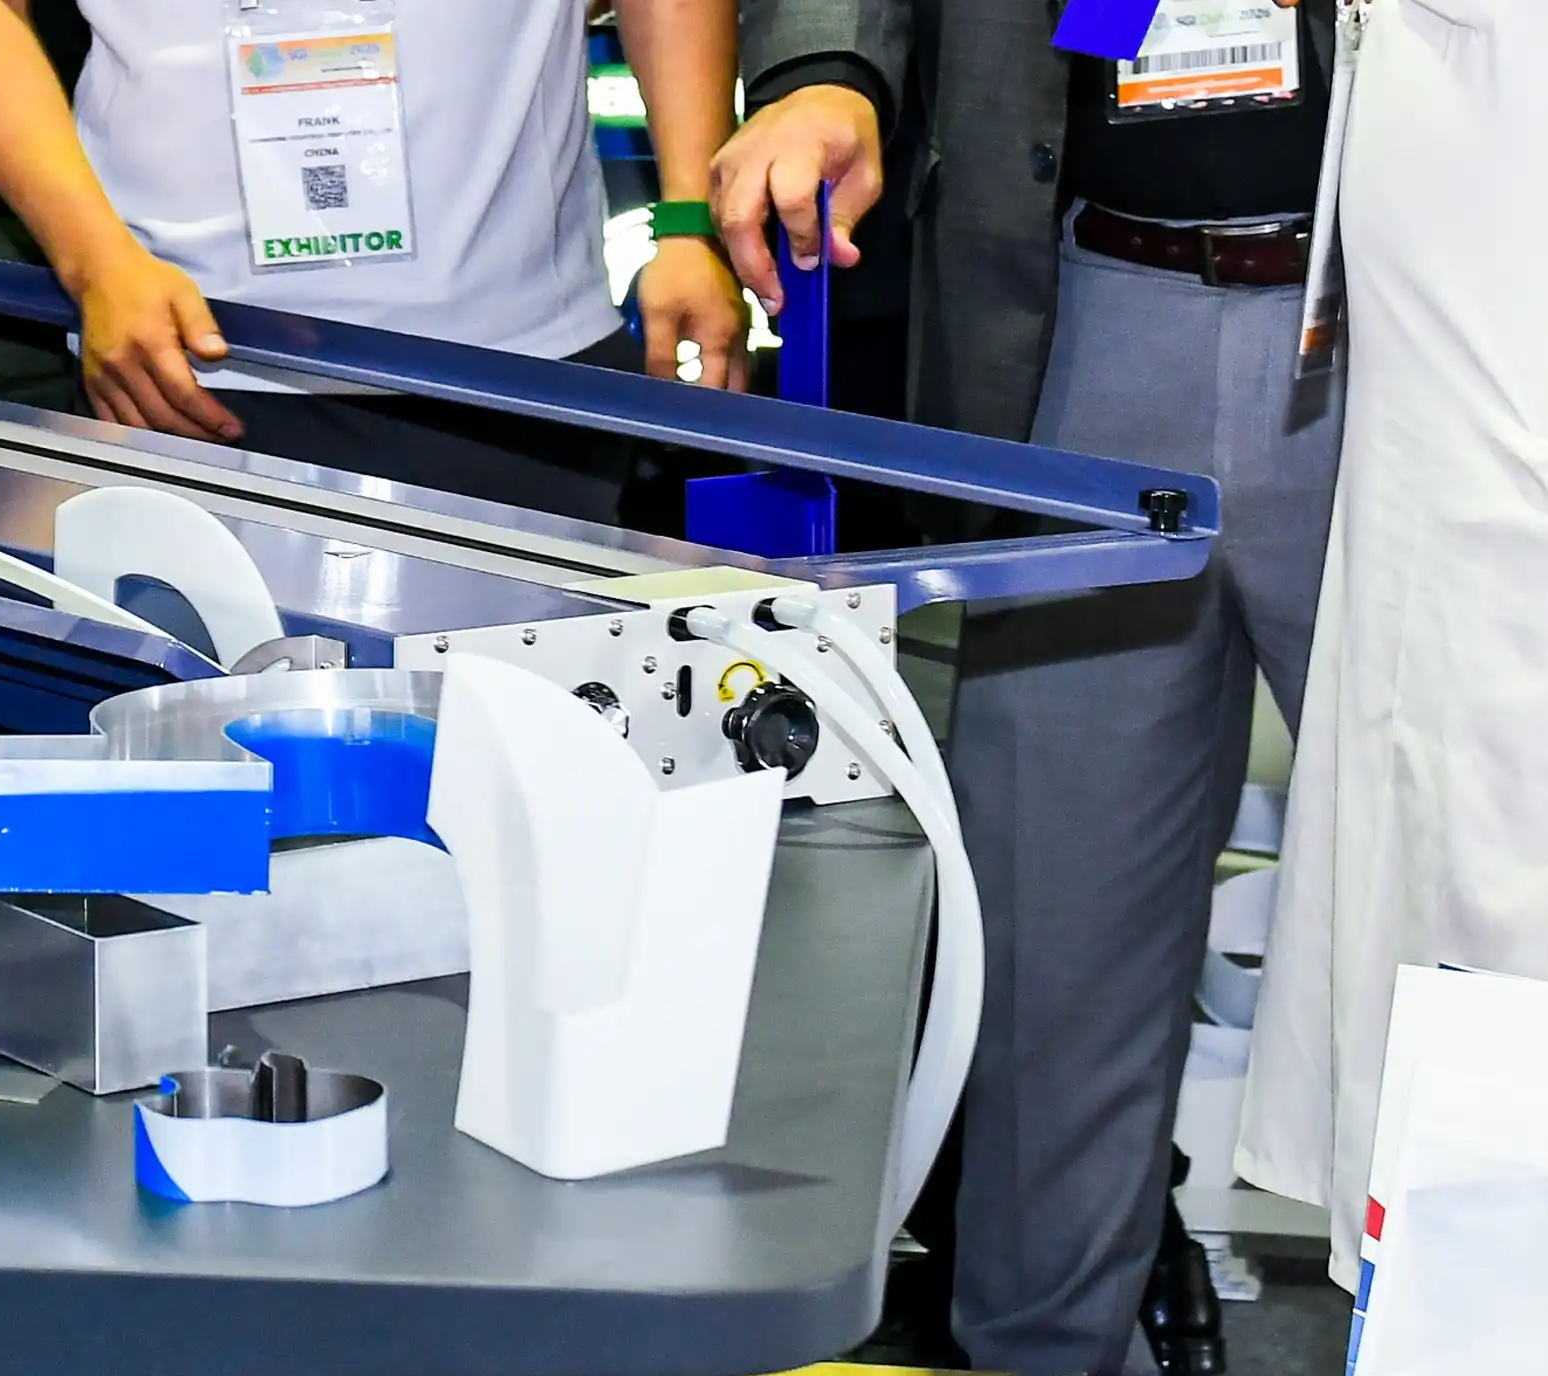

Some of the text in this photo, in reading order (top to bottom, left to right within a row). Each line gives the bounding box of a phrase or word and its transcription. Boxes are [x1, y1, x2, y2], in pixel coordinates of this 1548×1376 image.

[298, 115, 340, 128] FRANK
[304, 147, 339, 158] CHINA
[263, 230, 404, 259] EXHIBITOR
